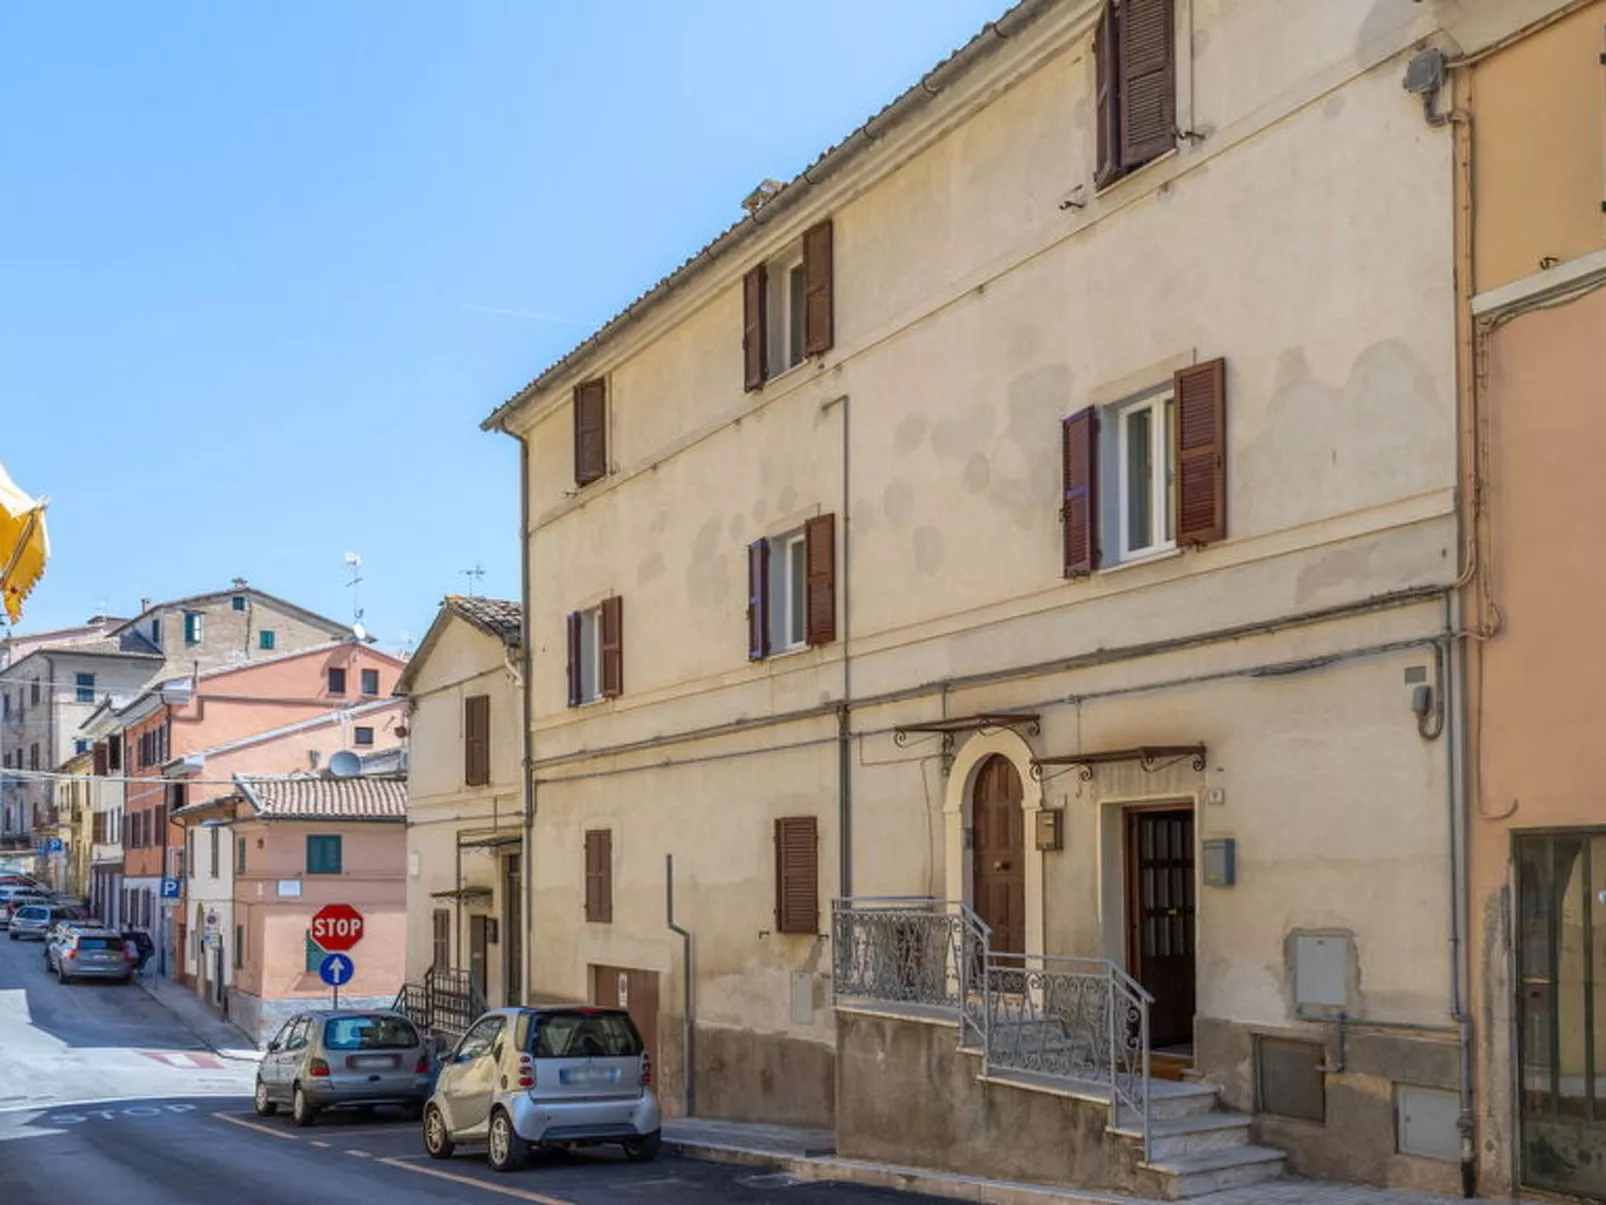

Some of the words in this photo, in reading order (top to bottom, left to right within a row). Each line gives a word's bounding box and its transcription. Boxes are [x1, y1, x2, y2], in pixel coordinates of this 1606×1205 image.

[164, 881, 177, 895] P
[314, 918, 361, 937] STOP
[51, 1103, 197, 1124] STOP
